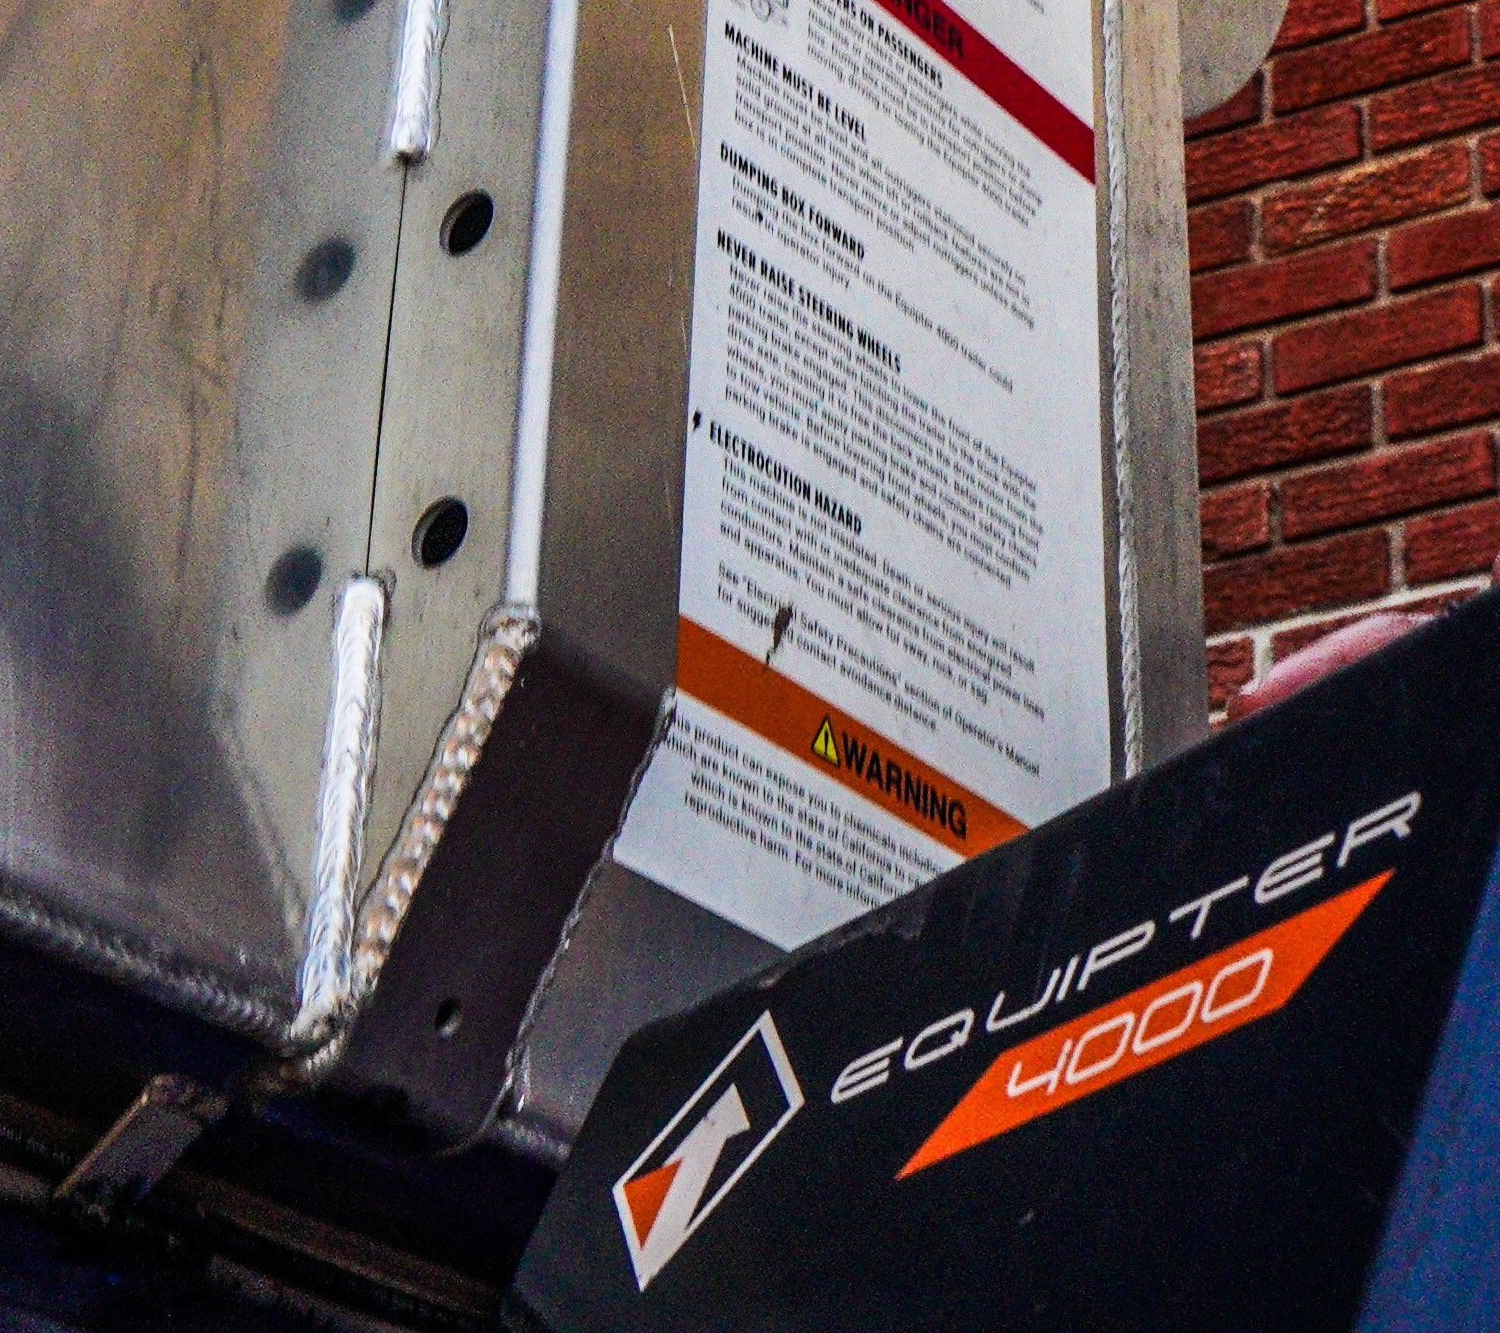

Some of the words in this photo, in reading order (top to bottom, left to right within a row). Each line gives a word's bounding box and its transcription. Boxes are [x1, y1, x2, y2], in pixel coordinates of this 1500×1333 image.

[724, 20, 778, 77] MACHINE
[782, 64, 813, 104] MUST
[817, 91, 830, 117] BE
[834, 105, 866, 145] LEVEL
[860, 7, 874, 35] OR
[878, 22, 942, 89] PASSENGERS
[720, 140, 777, 199] DUMPING
[781, 185, 805, 220] BOX
[809, 205, 864, 264] FORWARD
[717, 227, 756, 271] NEVER
[760, 258, 794, 299] RAISE
[798, 285, 853, 341] STEERING
[857, 327, 900, 374] WHEELS
[710, 419, 810, 503] ELECTROCUTION
[815, 488, 861, 536] HAZARD
[721, 473, 748, 506] from
[751, 493, 791, 534] contact
[794, 521, 817, 551] with
[749, 472, 794, 516] machine
[718, 559, 739, 588] See
[719, 517, 741, 546] and
[736, 594, 793, 646] sugged
[796, 631, 836, 673] contact
[694, 719, 739, 767] product
[842, 731, 966, 841] WARNING
[830, 791, 1421, 1104] EQUIPTER
[1007, 948, 1273, 1096] 4000
